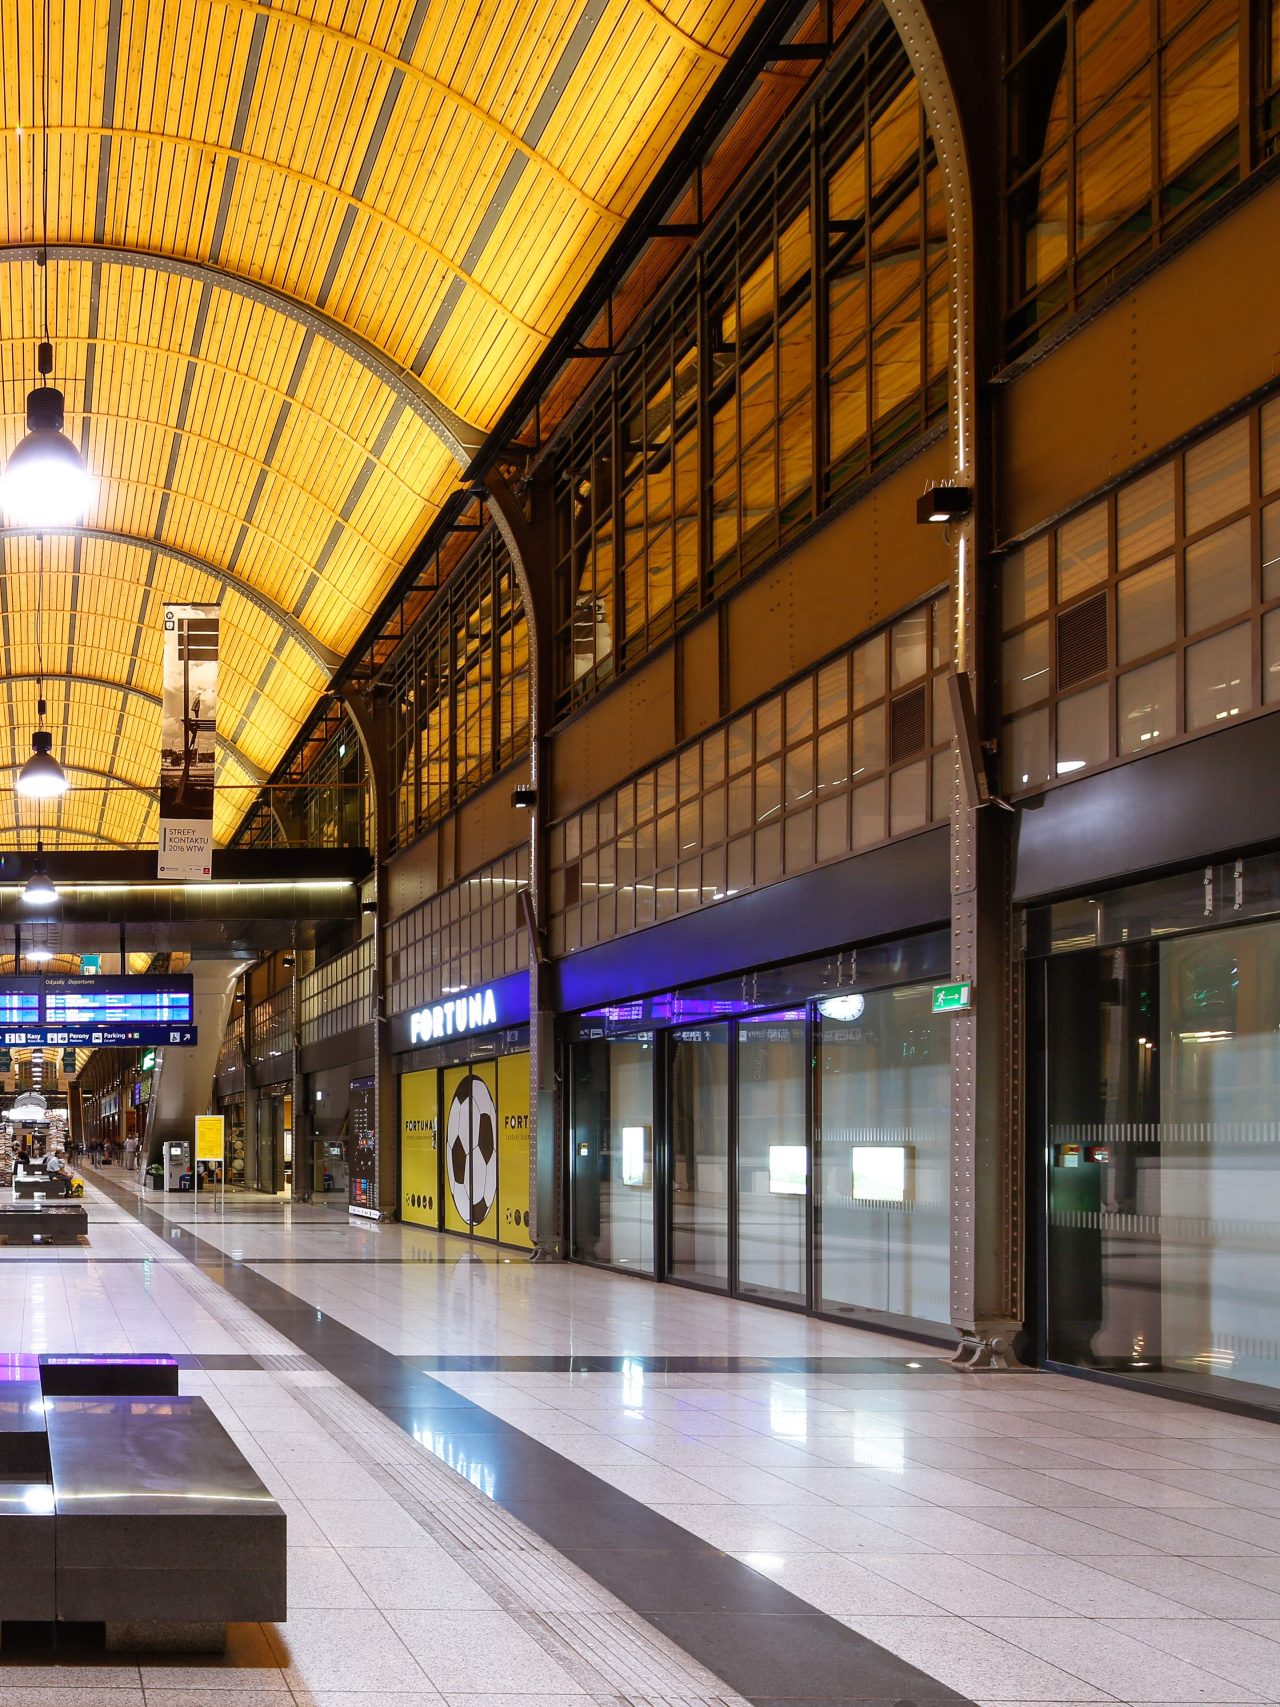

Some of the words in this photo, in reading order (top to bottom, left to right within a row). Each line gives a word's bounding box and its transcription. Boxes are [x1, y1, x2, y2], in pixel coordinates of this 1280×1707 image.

[169, 828, 196, 836] STREFY
[169, 837, 209, 845] KONTAKTU
[411, 989, 497, 1044] FORTUNA
[405, 1120, 433, 1132] FORTUNA
[504, 1115, 529, 1130] FORT
